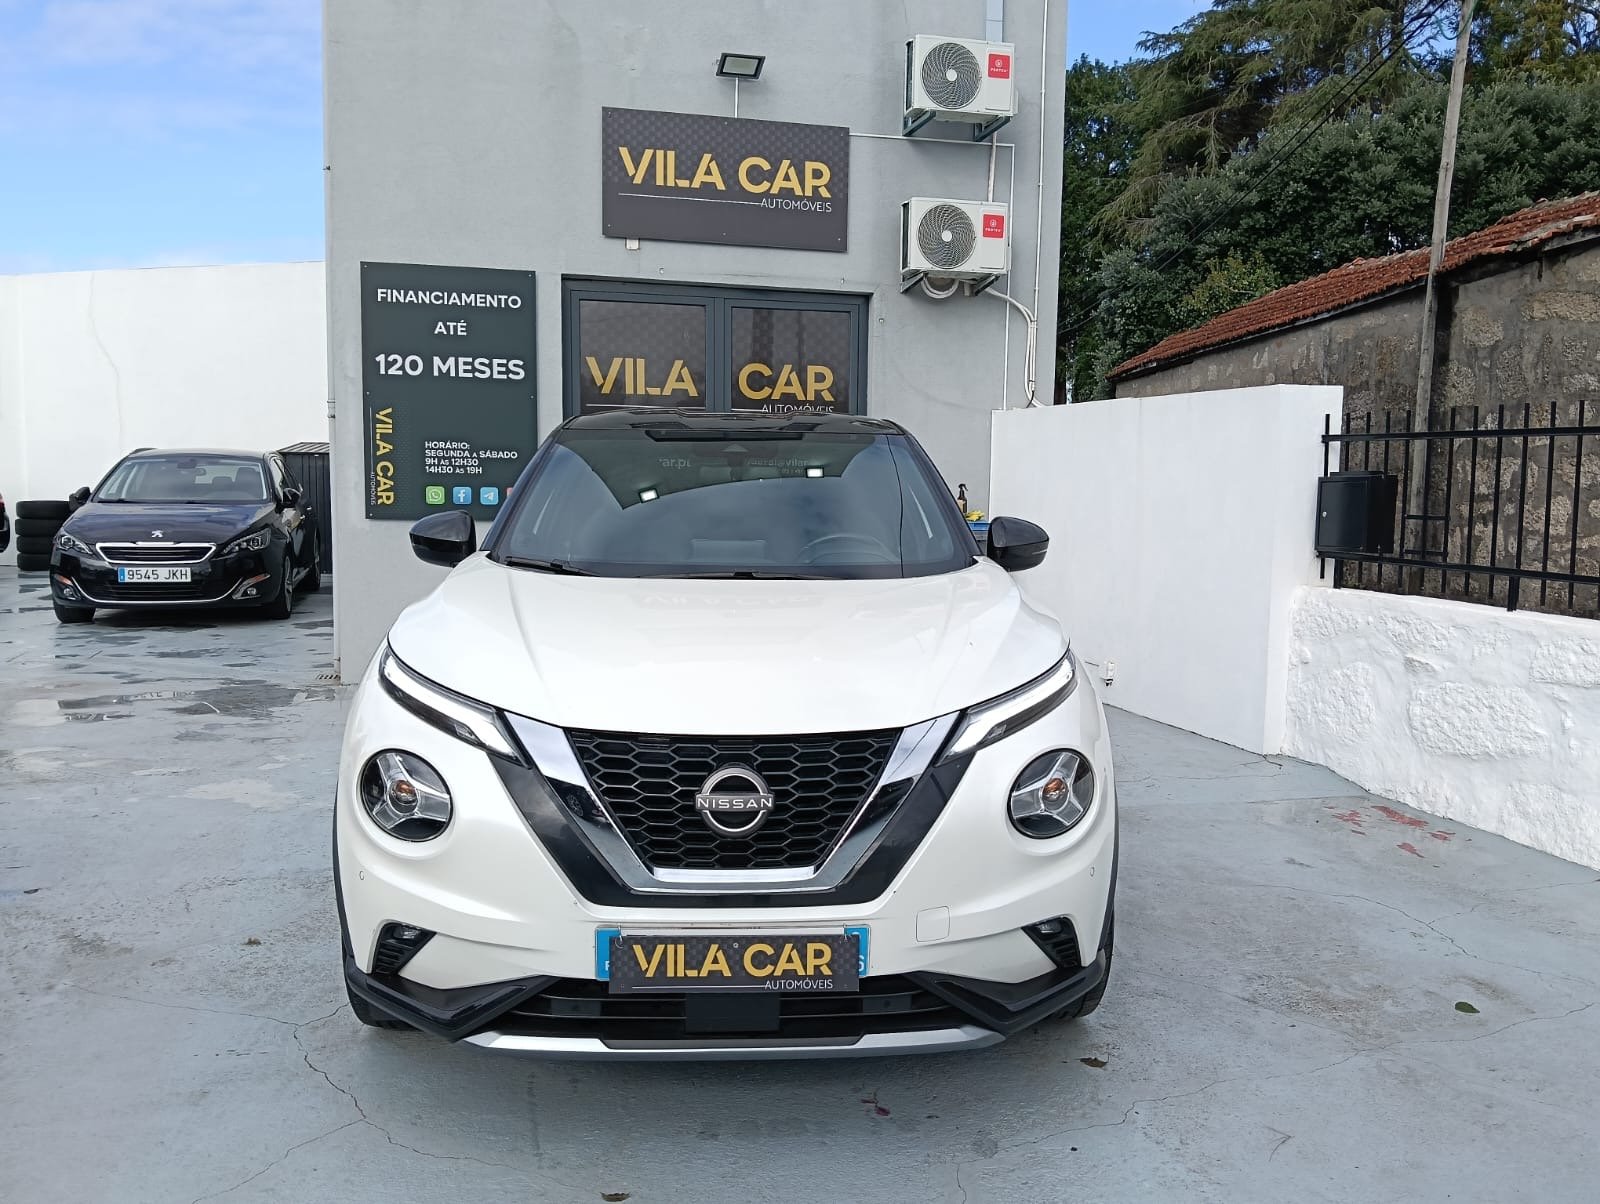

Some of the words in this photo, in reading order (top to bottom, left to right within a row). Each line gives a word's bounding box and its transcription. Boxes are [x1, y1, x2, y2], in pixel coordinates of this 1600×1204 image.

[618, 146, 726, 190] VILA
[738, 156, 832, 198] CAR
[760, 198, 833, 213] AUTOMÓVEIS
[377, 288, 522, 309] FINANCIAMENTO
[434, 320, 467, 336] ATÉ
[375, 353, 424, 376] 120
[433, 356, 525, 380] MESES
[585, 356, 699, 397] VILA
[738, 362, 835, 401] CAR
[375, 407, 393, 456] VILA
[425, 440, 470, 450] HORÁRIO:
[425, 450, 470, 458] SEGUNDA
[479, 449, 518, 459] SÁBADO
[425, 457, 438, 466] 9H
[451, 458, 479, 466] 12H30
[425, 466, 453, 474] 14H30
[466, 466, 483, 475] 19H
[376, 461, 395, 505] CAR
[127, 569, 159, 580] 9545
[164, 569, 188, 580] JKH
[697, 797, 772, 809] NISSAN
[632, 943, 732, 978] VILA
[743, 942, 833, 978] CAR
[764, 977, 833, 990] AUTOMÓVEIS
